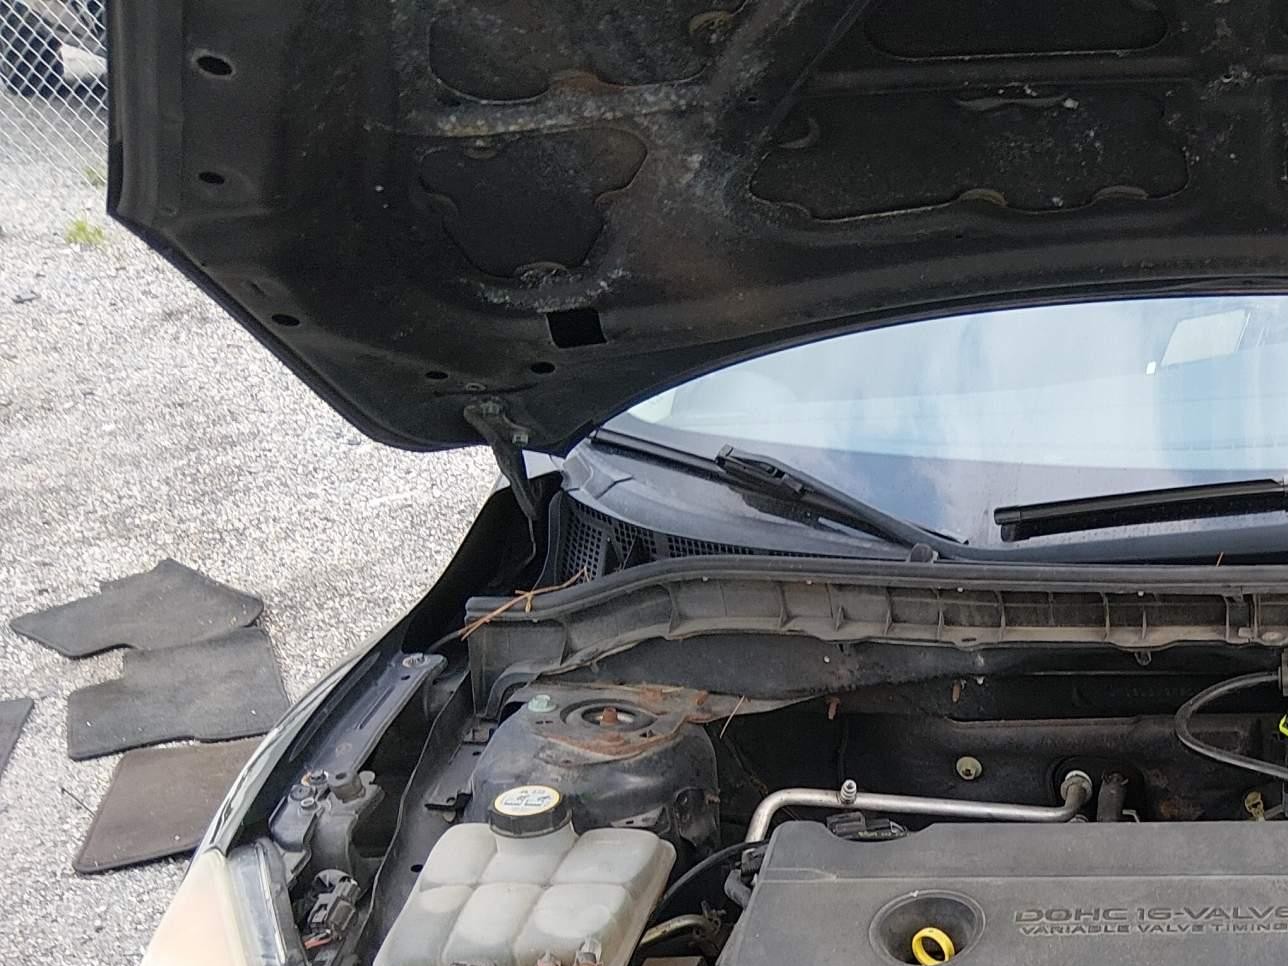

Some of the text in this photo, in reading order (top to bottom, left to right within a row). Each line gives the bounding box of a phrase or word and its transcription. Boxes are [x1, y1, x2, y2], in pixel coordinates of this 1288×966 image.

[1014, 907, 1129, 923] DOHC
[1020, 924, 1131, 936] VARIABLE
[1137, 923, 1204, 934] VALVE
